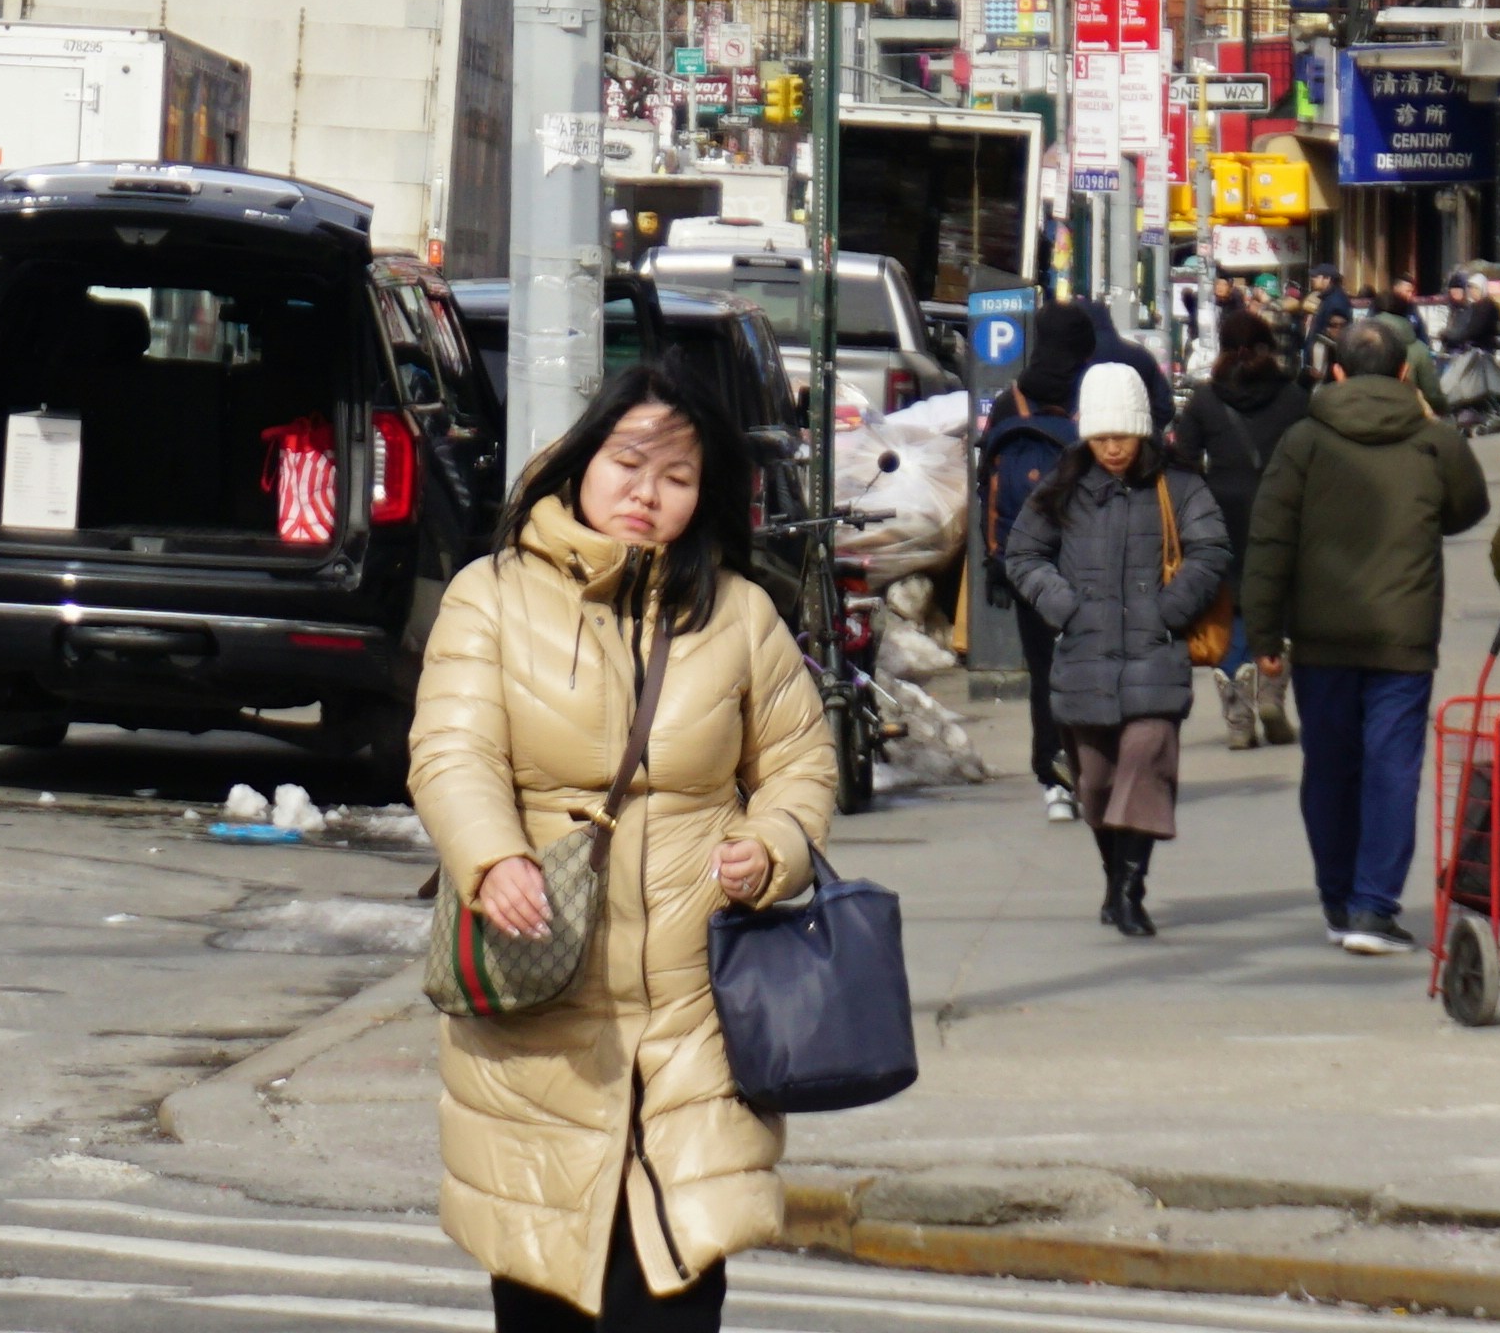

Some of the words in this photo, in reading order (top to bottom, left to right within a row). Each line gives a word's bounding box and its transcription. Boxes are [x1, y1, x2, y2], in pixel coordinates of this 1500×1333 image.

[63, 39, 103, 53] 478295
[1077, 55, 1087, 75] 3
[1223, 85, 1259, 100] WAY
[1392, 132, 1452, 149] CENTURY
[1375, 152, 1473, 170] DERMATOLOGY
[990, 320, 1015, 358] P
